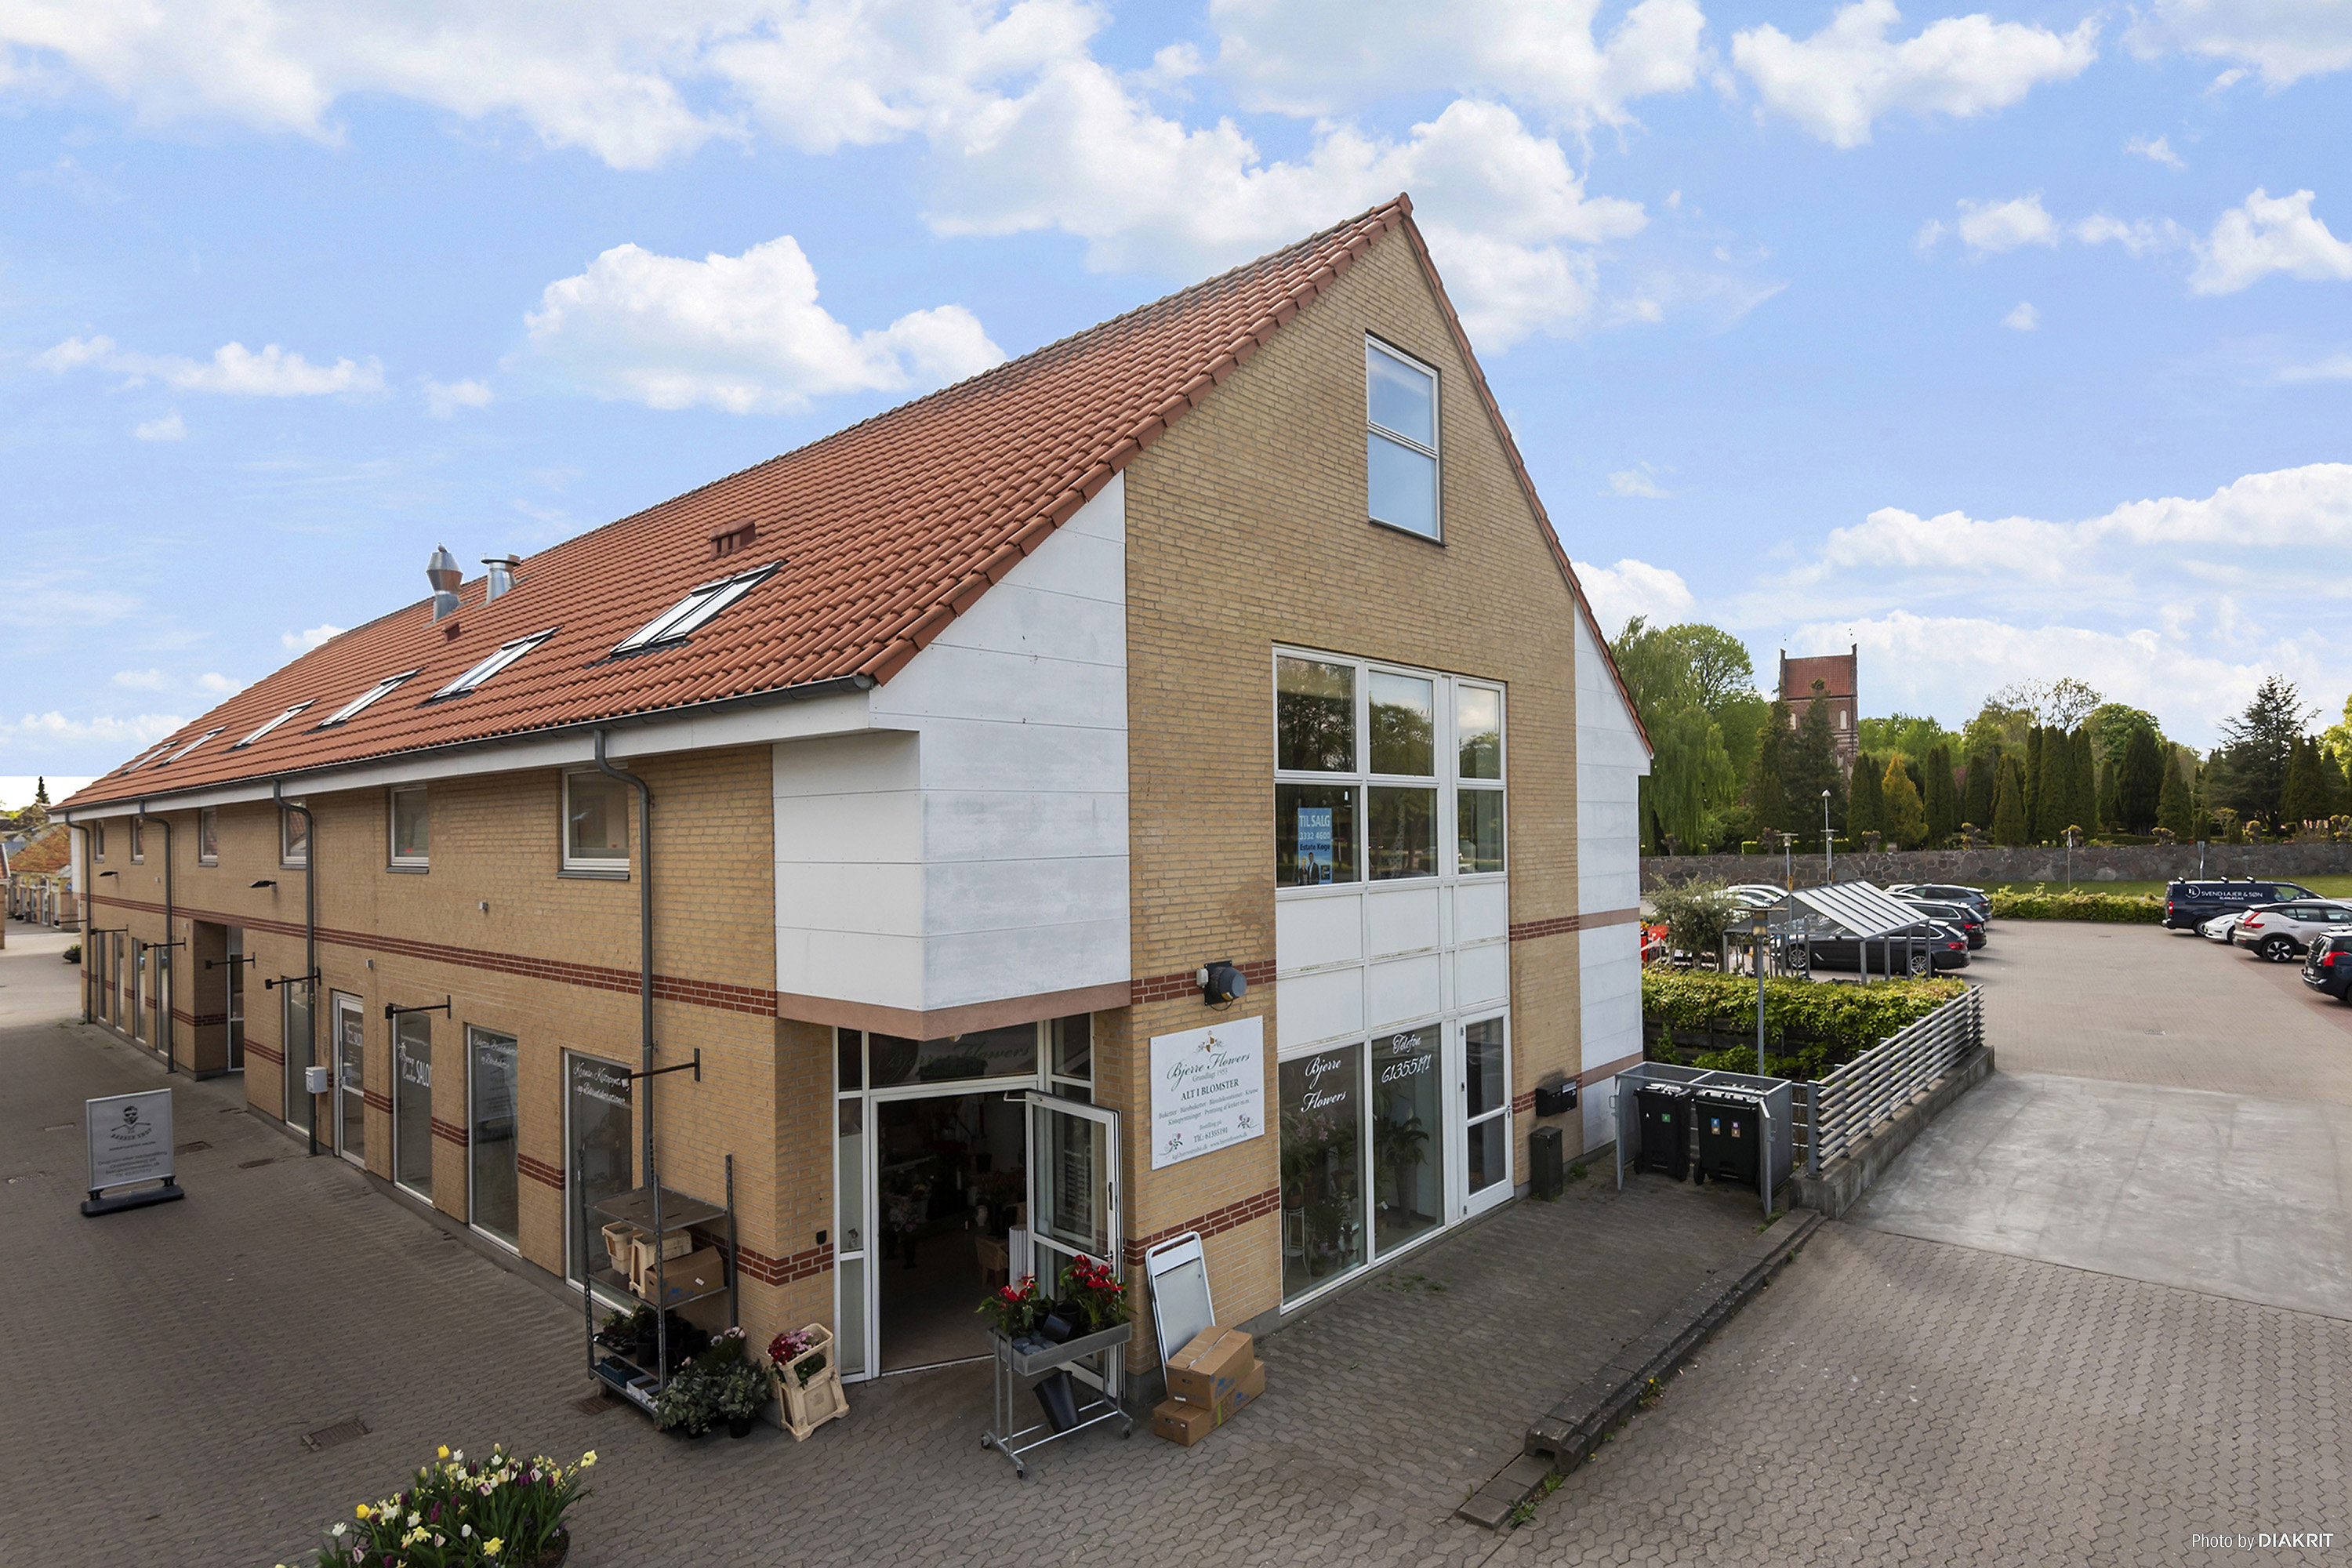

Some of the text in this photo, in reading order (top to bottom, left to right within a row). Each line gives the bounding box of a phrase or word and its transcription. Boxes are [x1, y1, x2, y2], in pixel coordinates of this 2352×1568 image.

[1299, 815, 1330, 827] TIL SALG
[1167, 1051, 1250, 1091] Bjerre Flowers
[1305, 1053, 1341, 1089] Bjerre
[1381, 1054, 1432, 1083] 61355191
[1181, 1079, 1239, 1101] ALT I BLOMSTER
[1301, 1090, 1347, 1112] Flowers
